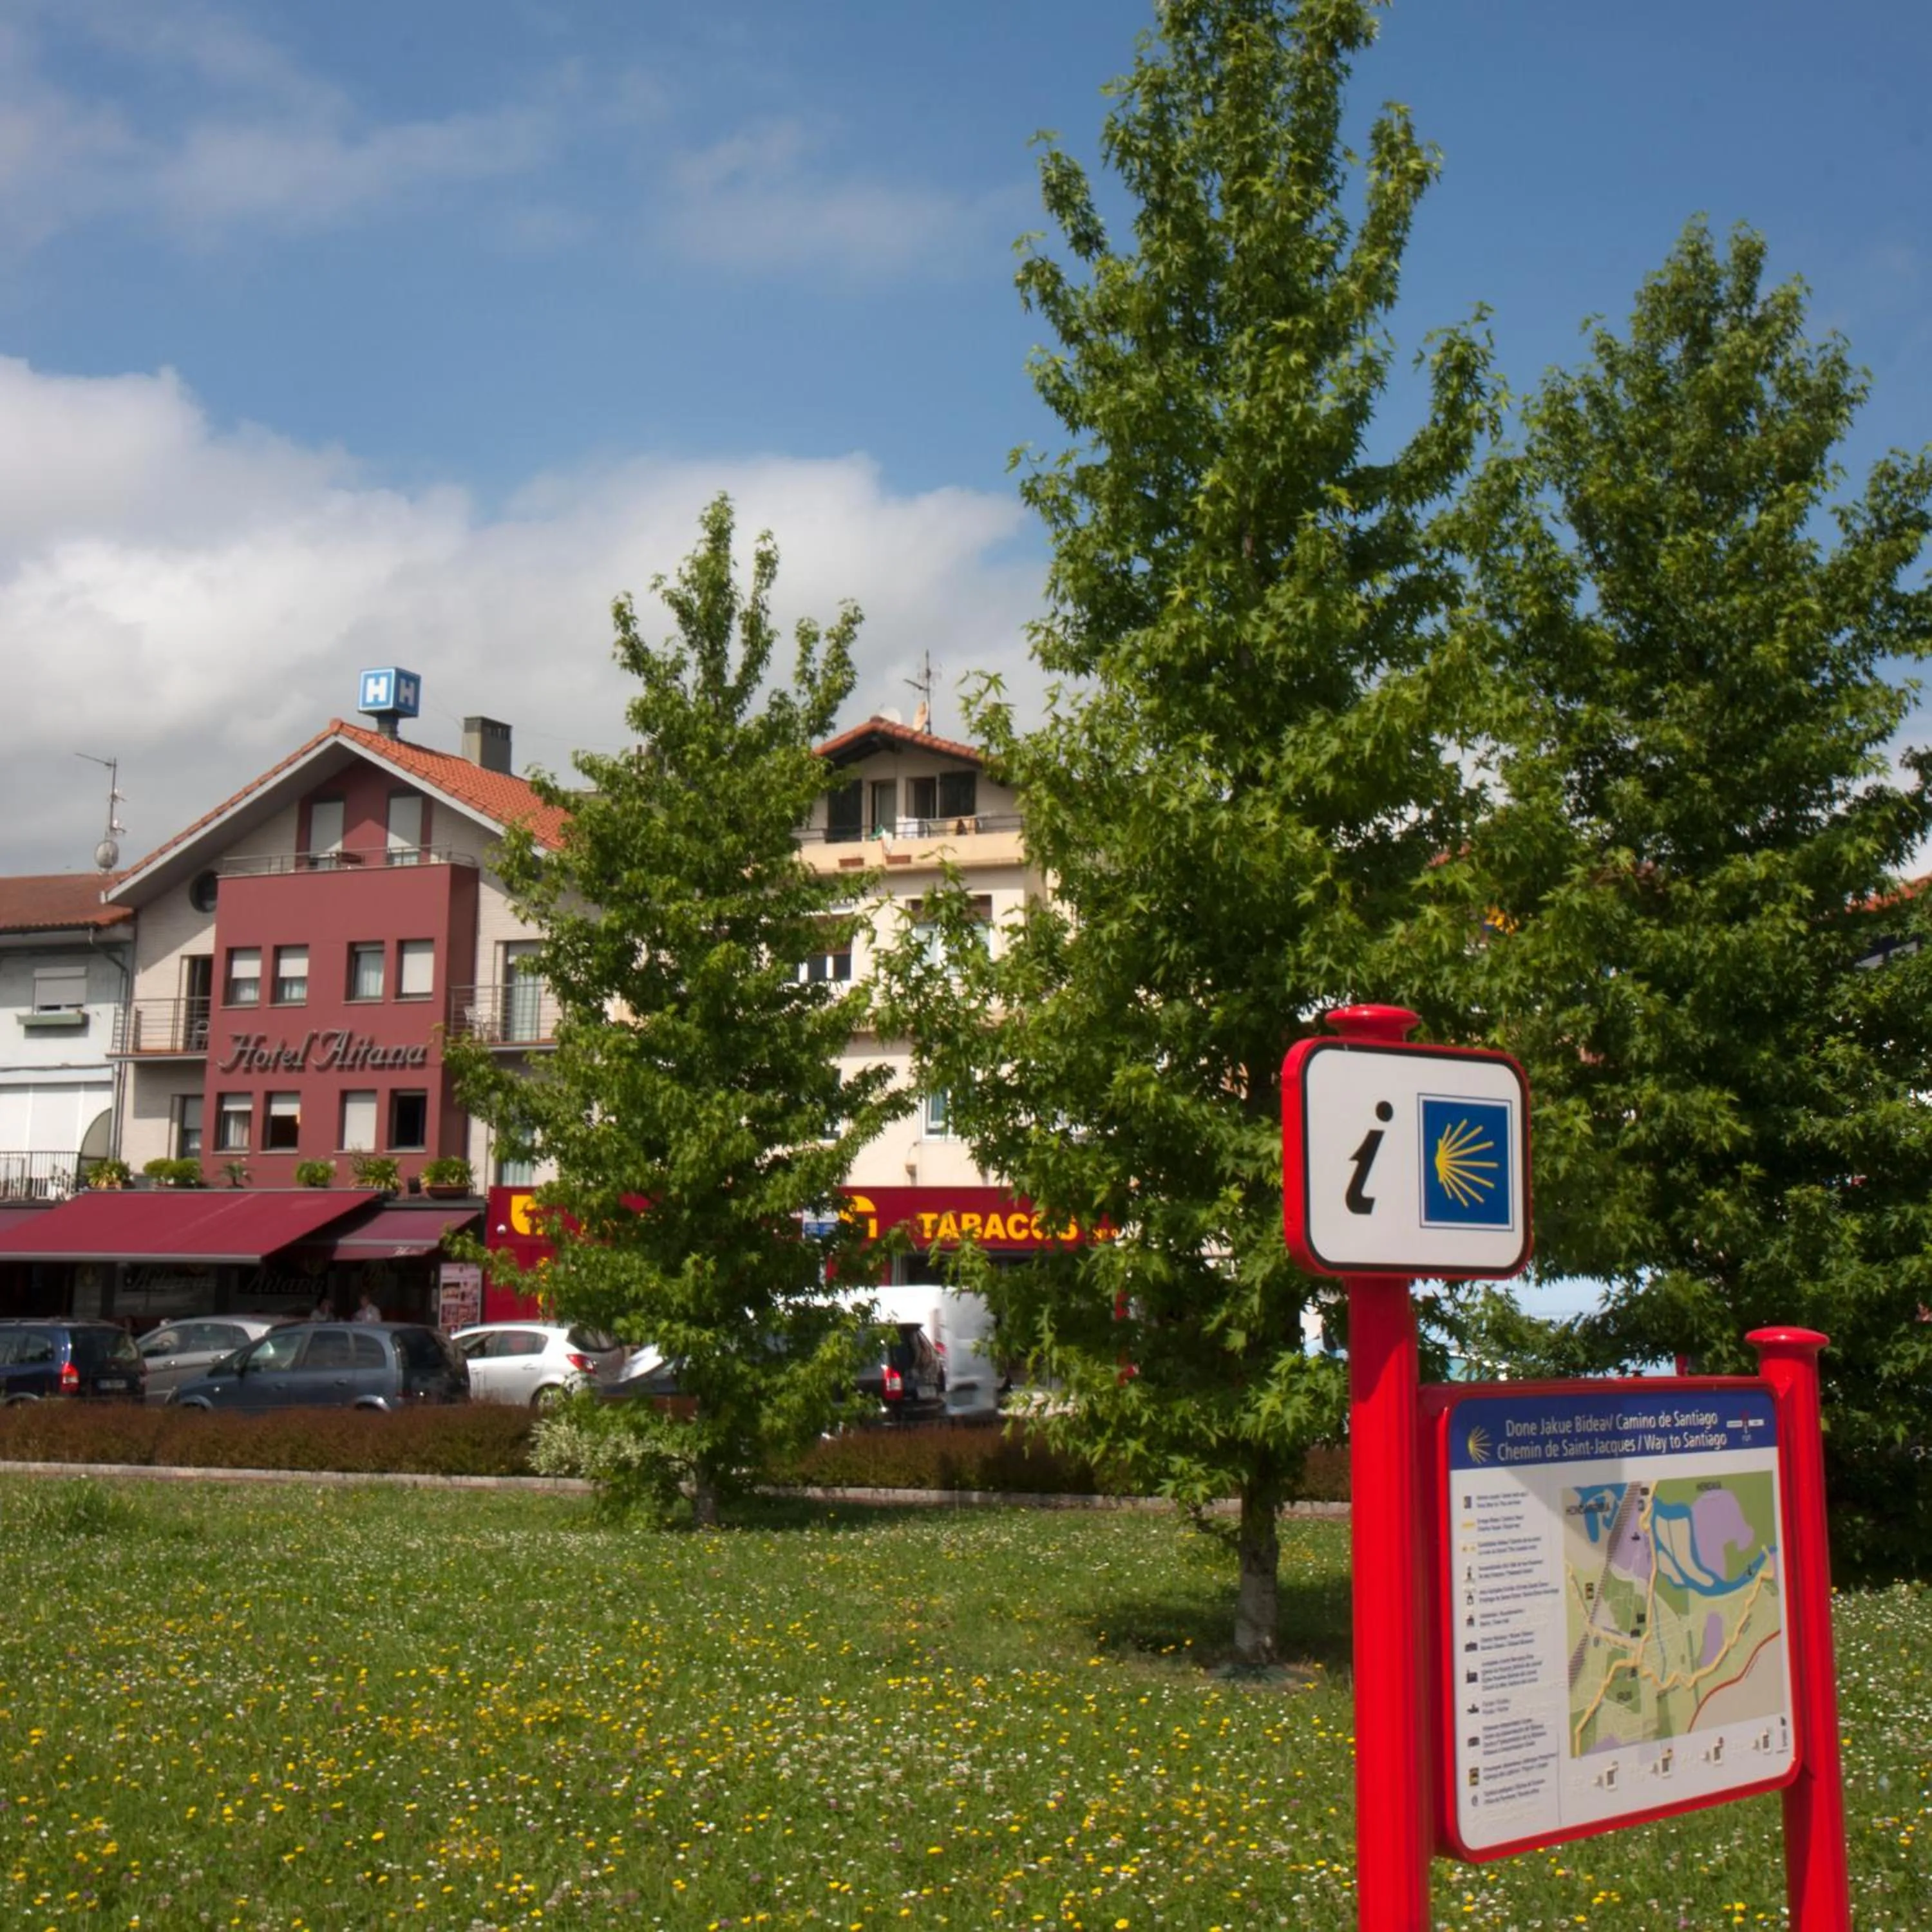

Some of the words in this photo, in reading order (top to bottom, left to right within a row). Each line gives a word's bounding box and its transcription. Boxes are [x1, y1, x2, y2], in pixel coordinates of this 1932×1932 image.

[365, 677, 388, 703] H
[399, 678, 415, 706] H
[217, 1030, 317, 1073] Hotel
[312, 1029, 428, 1071] Aitana
[1345, 1101, 1394, 1215] i
[1506, 1419, 1537, 1437] Done
[1540, 1416, 1572, 1435] Jakue
[1616, 1412, 1656, 1430] Camino
[1658, 1410, 1672, 1428] de
[1674, 1409, 1718, 1430] Santiago
[1497, 1442, 1542, 1461] Chemin
[1545, 1439, 1559, 1457] de
[1561, 1437, 1636, 1457] Saint-Jacques
[1643, 1434, 1667, 1454] Way
[1669, 1434, 1681, 1449] to
[1683, 1430, 1727, 1450] Santiago
